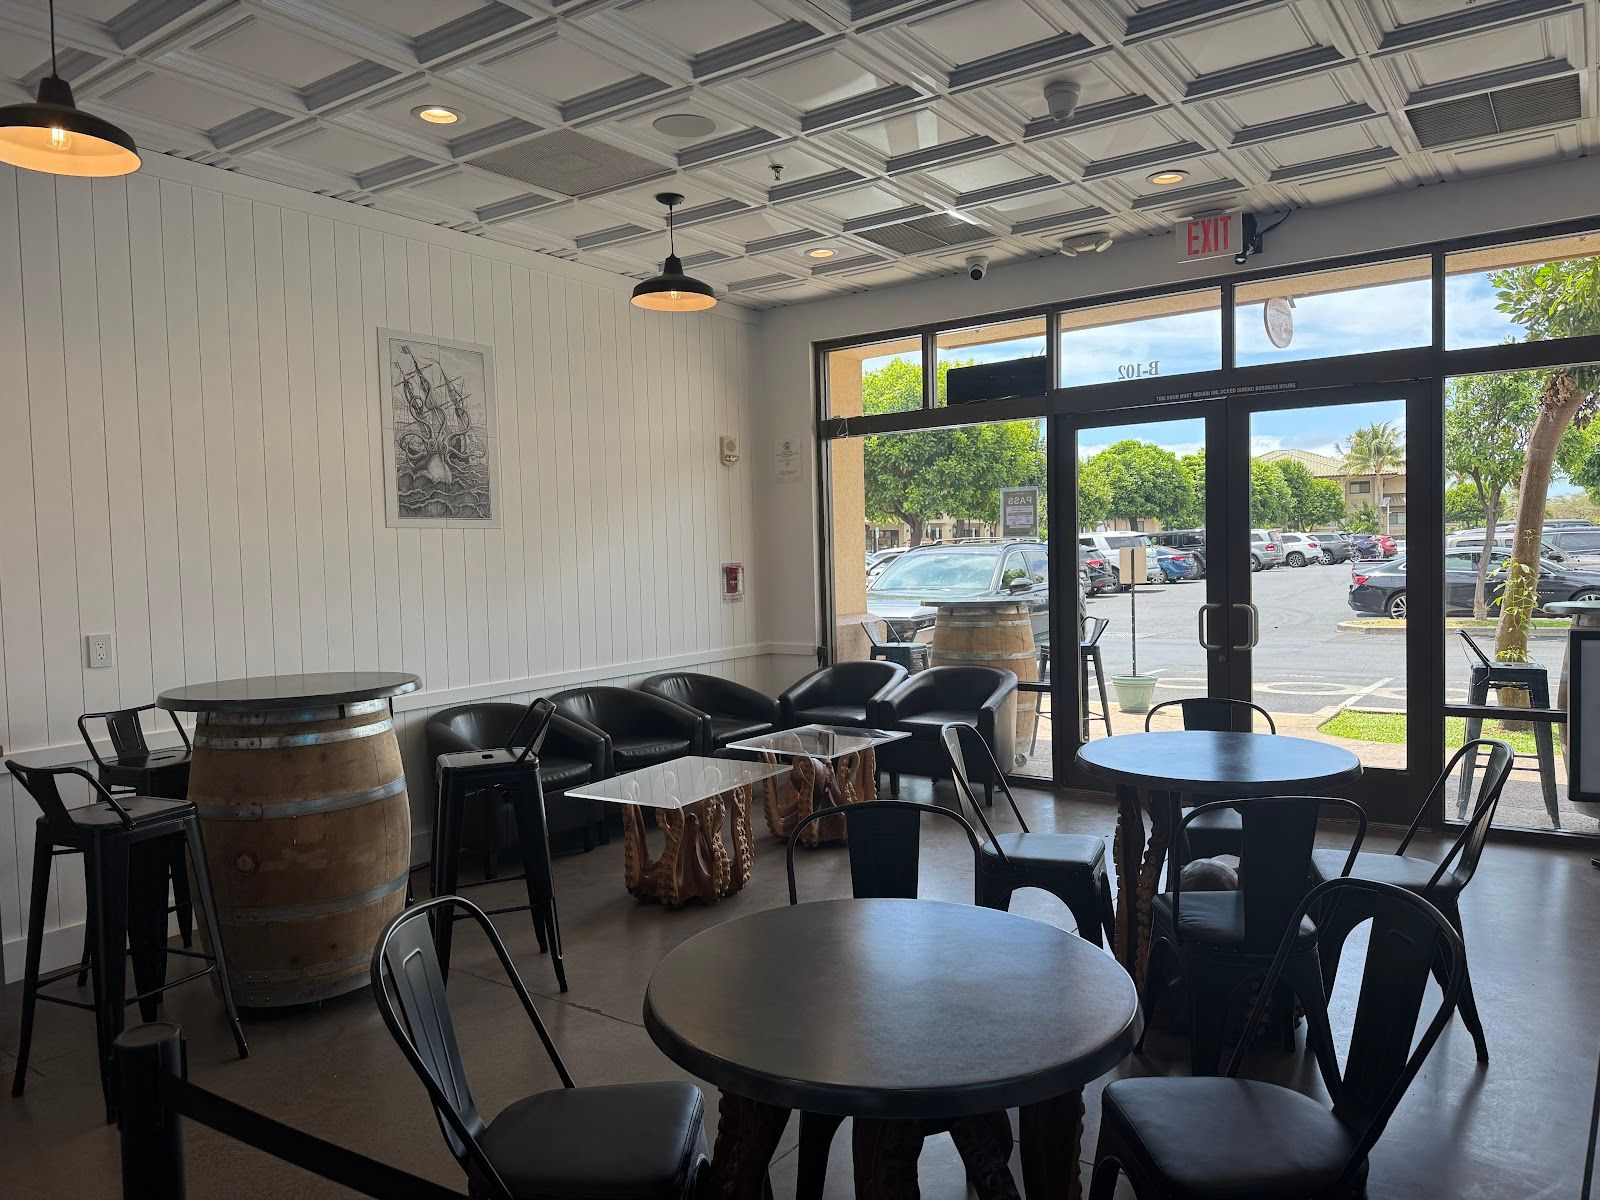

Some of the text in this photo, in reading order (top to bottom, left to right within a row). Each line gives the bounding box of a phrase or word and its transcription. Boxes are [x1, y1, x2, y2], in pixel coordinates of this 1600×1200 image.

[1187, 215, 1232, 256] EXIT
[1193, 390, 1210, 398] REMAIN
[1211, 388, 1236, 396] UNLOCKED
